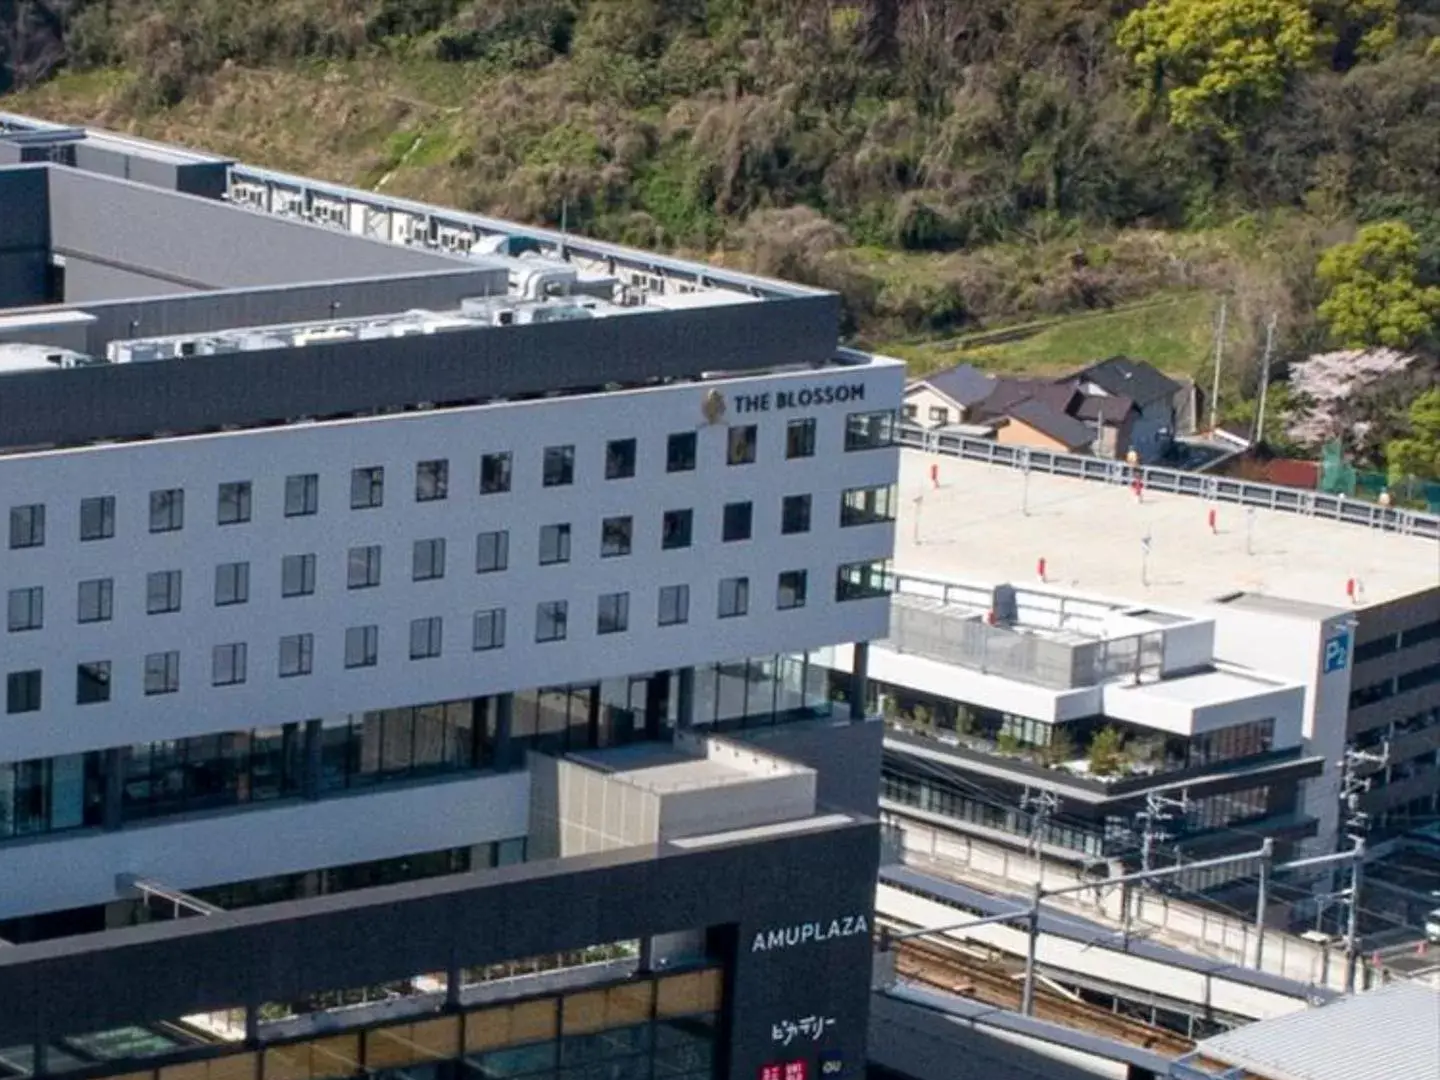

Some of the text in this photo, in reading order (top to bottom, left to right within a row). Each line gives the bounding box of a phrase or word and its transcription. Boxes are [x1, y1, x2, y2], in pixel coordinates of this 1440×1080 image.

[734, 383, 865, 414] THE BLOSSOM
[751, 915, 868, 952] AMUPLAZA
